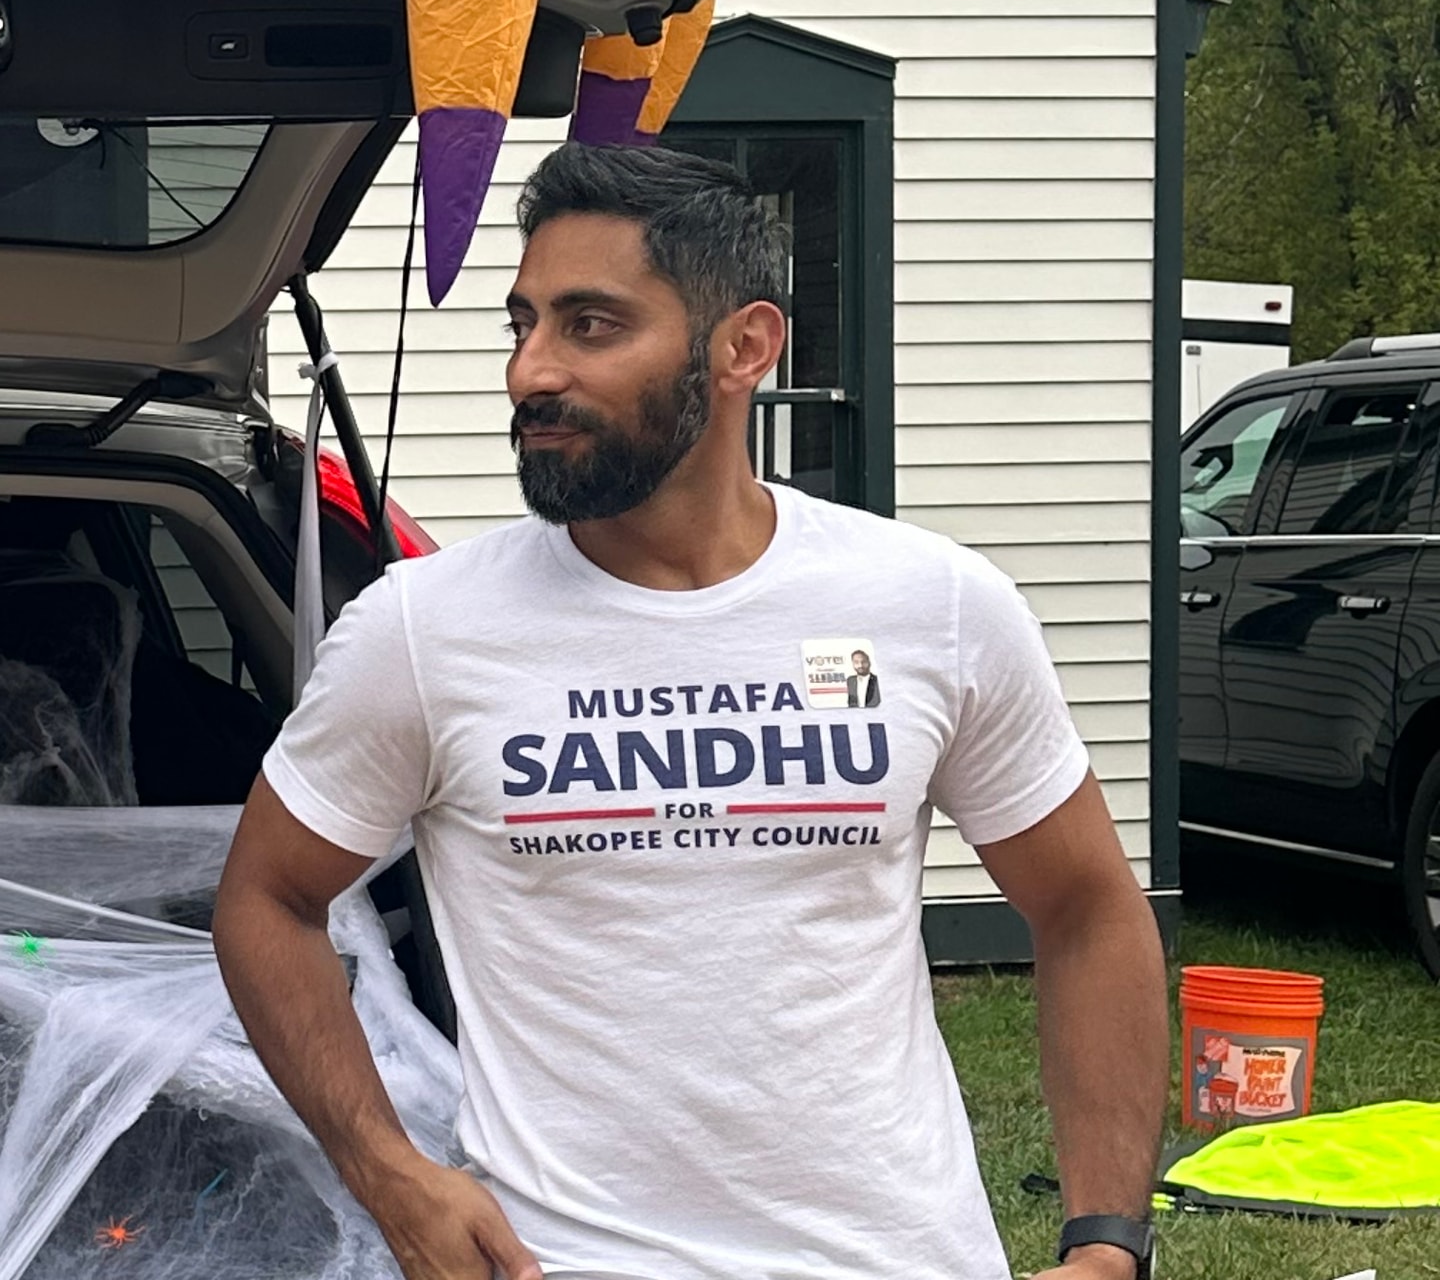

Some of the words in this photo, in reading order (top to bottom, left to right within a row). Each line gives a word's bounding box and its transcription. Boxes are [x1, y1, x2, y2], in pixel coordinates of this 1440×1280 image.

[568, 681, 804, 718] MUSTAFA
[502, 723, 890, 797] SANDHU
[665, 803, 715, 819] FOR
[509, 829, 662, 855] SHAKOPEE
[674, 827, 740, 849] CITY
[752, 826, 881, 847] COUNCIL
